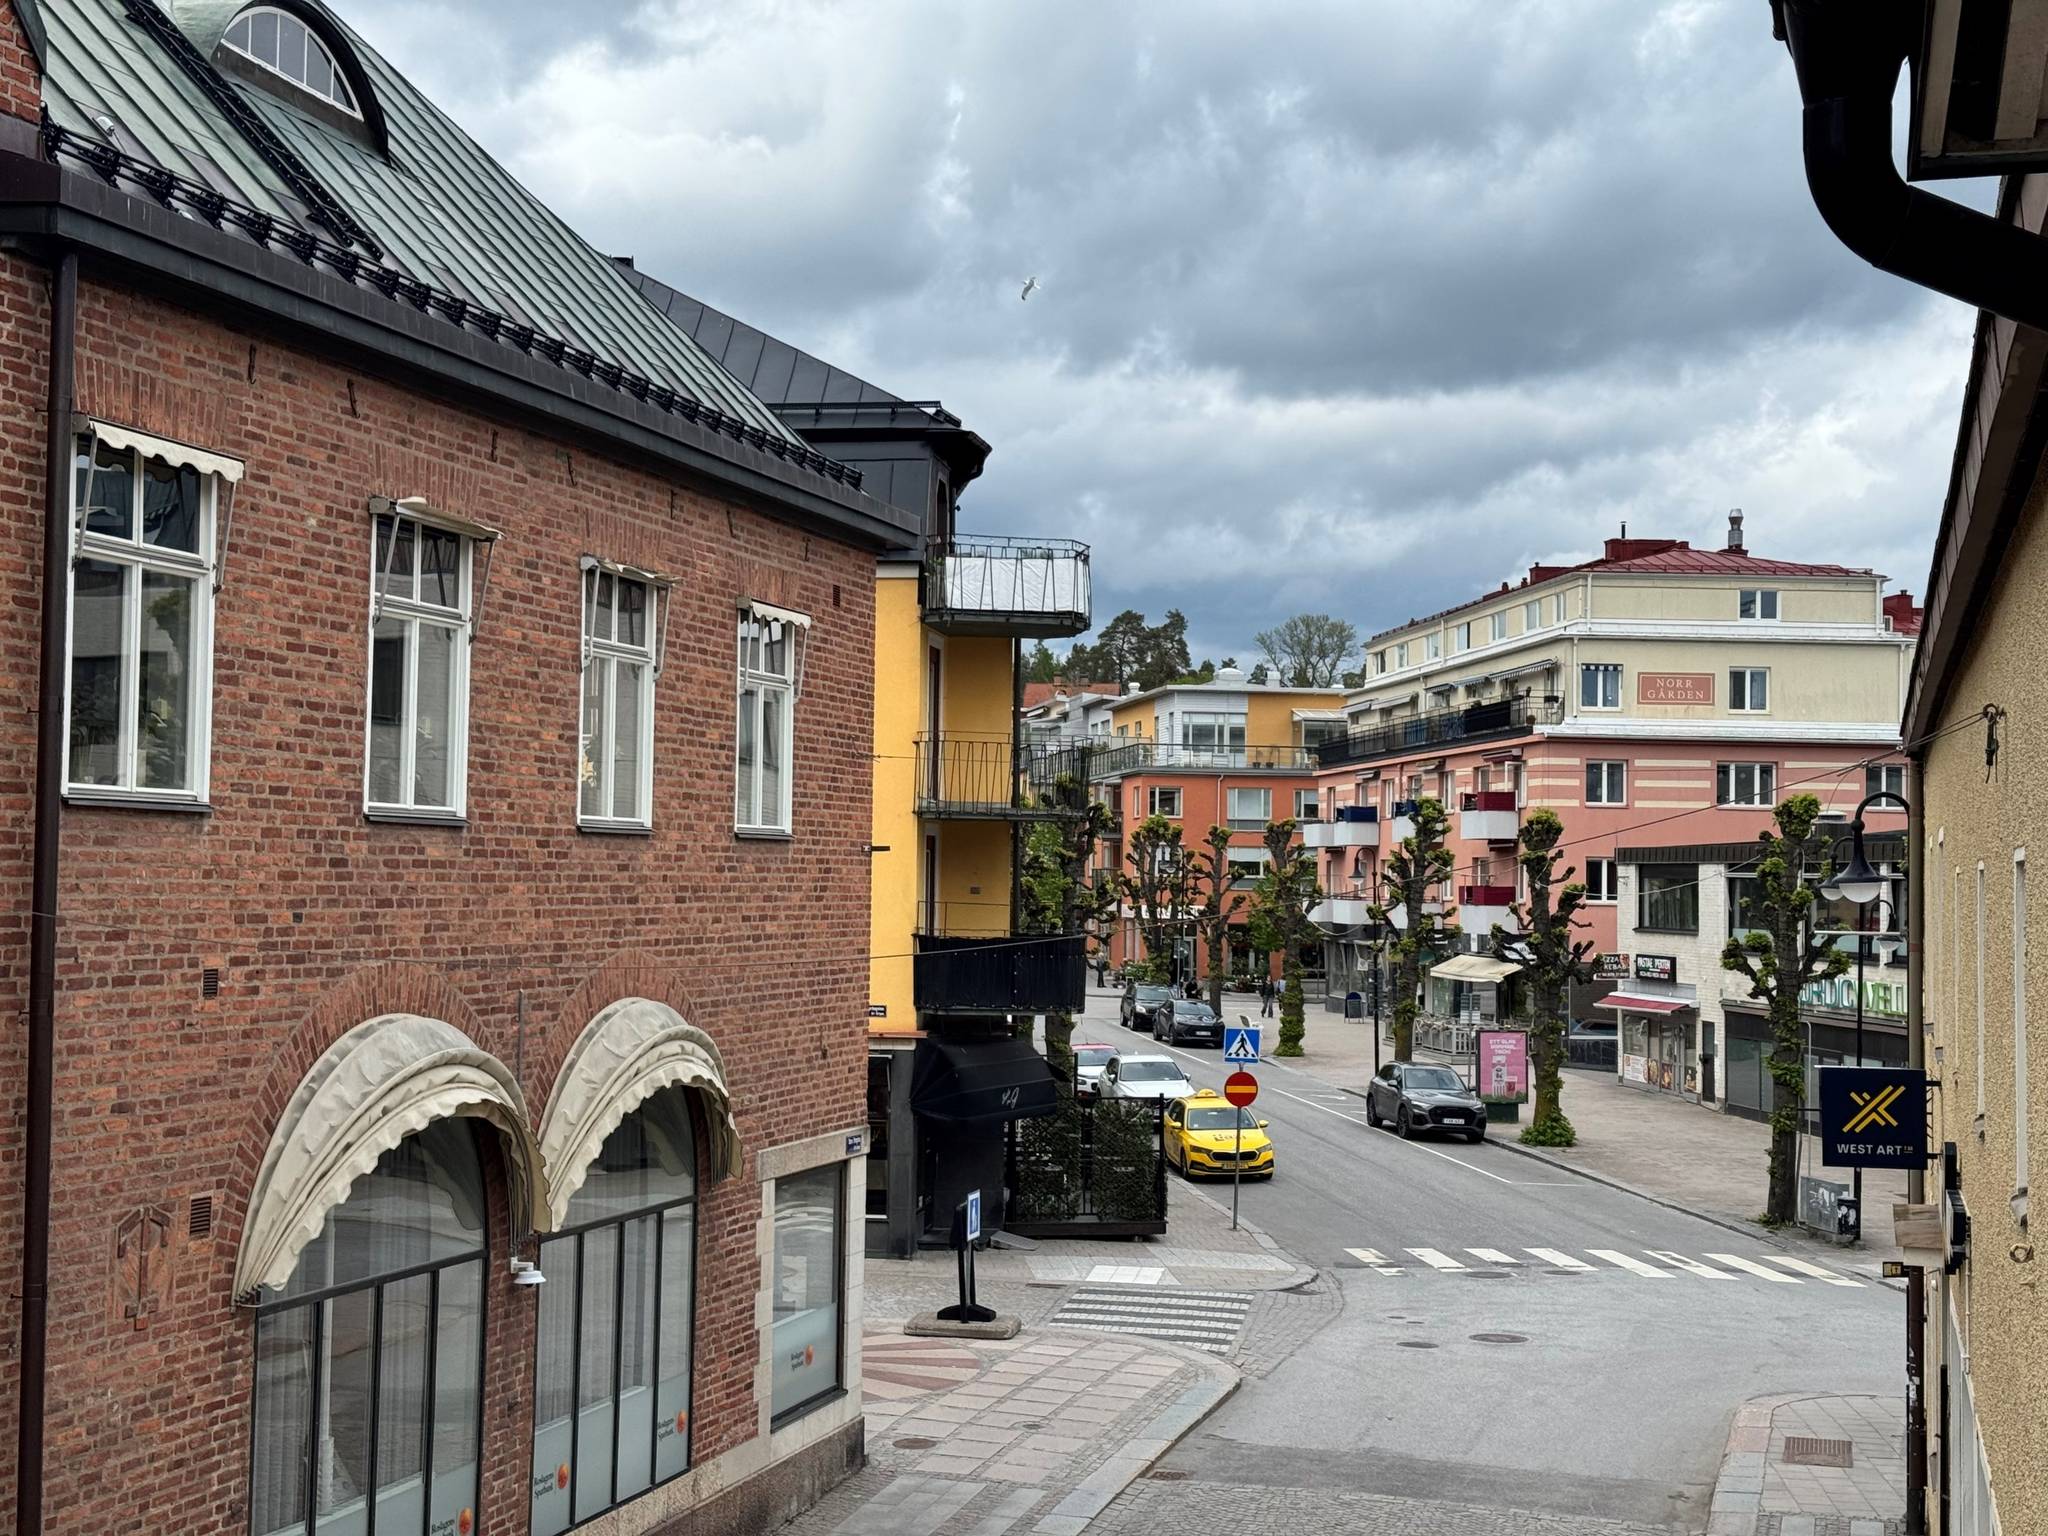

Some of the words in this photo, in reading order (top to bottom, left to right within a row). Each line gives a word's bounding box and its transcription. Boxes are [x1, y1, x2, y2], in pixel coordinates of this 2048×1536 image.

[1656, 678, 1693, 688] NORR
[1647, 687, 1704, 699] GÅRDEN
[1837, 1144, 1873, 1154] WEST
[1876, 1145, 1902, 1155] ART
